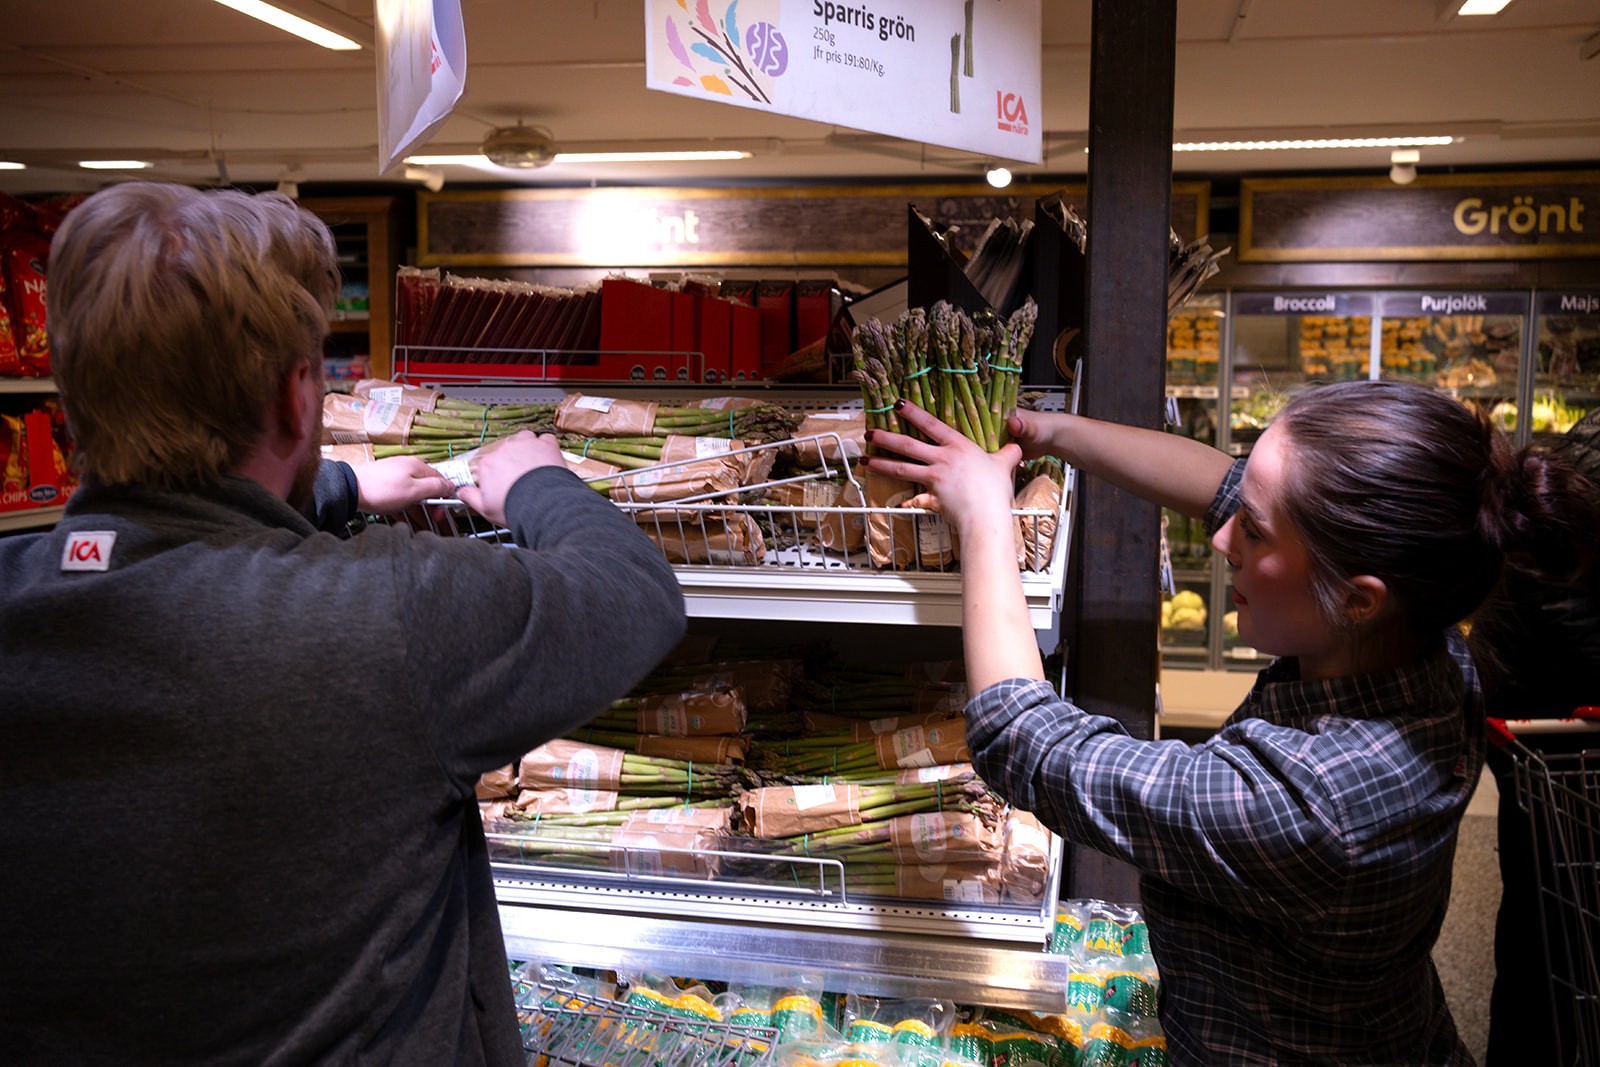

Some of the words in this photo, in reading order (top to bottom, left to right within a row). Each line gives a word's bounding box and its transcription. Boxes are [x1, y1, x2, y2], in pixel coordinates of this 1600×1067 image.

[813, 0, 875, 31] Sparris
[878, 15, 915, 42] grön
[813, 26, 836, 47] 250g
[813, 45, 824, 60] Jfr
[825, 50, 842, 64] pris
[843, 52, 886, 78] 191:80/Kg.
[997, 90, 1029, 126] ICA
[1453, 195, 1585, 235] Grönt
[1273, 294, 1337, 312] Broccoli
[1421, 294, 1488, 314] Purjolök
[3, 490, 28, 504] CHIPS
[68, 540, 102, 562] ICA
